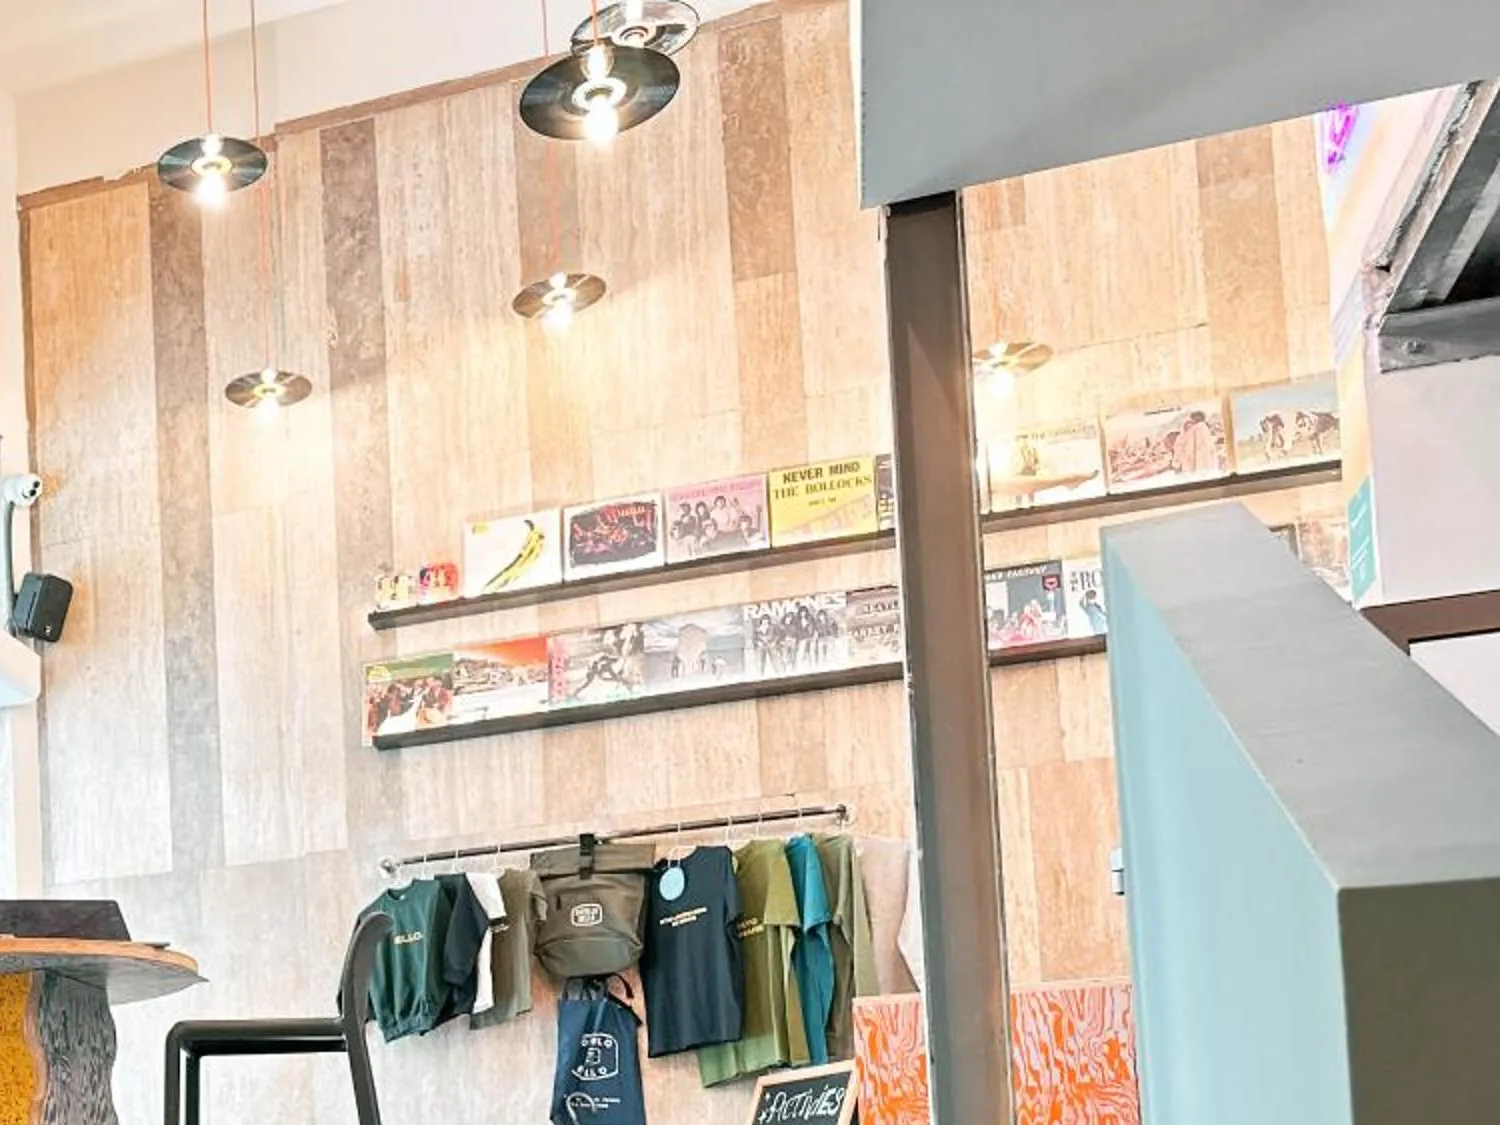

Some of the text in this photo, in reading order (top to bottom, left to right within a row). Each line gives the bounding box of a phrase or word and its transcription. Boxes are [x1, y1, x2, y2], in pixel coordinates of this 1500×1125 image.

[783, 461, 861, 484] NEVER MIND
[773, 485, 799, 500] THE
[805, 475, 872, 494] BOLLOCKS
[743, 591, 846, 621] RAMONES
